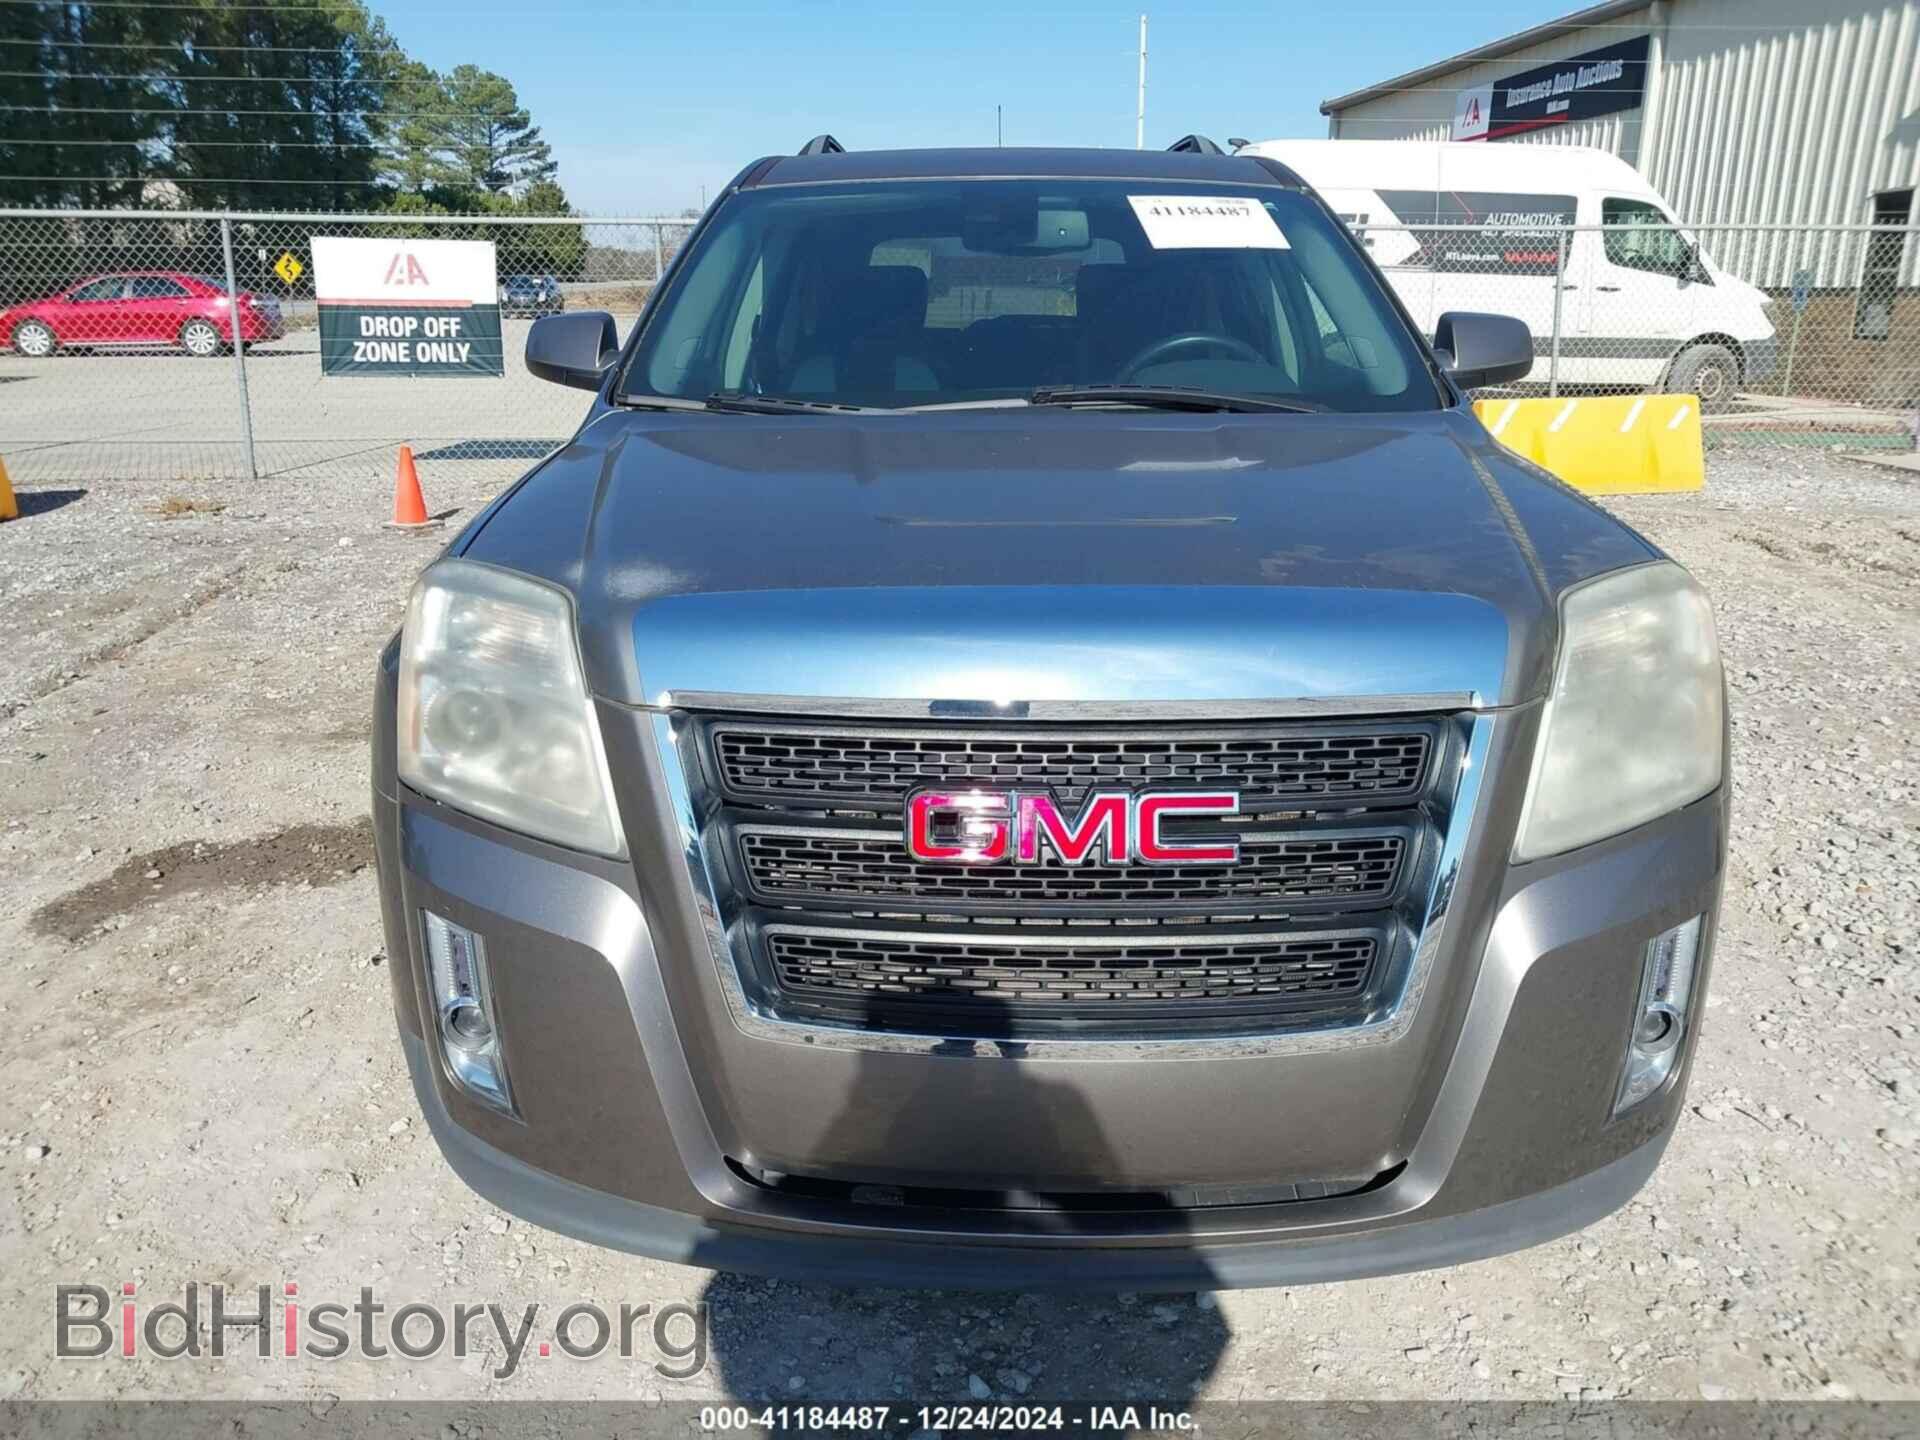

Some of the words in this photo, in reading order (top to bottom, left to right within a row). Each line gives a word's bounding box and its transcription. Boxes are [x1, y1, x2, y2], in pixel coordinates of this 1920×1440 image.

[1506, 79, 1552, 108] Insurance
[1552, 72, 1576, 95] Auto
[1575, 59, 1624, 89] Auctions
[1149, 206, 1250, 216] 41184487
[1484, 212, 1565, 225] AUTOMOTIVE
[359, 316, 418, 337] DROP
[424, 316, 462, 338] OFF
[353, 341, 410, 363] ZONE
[416, 342, 471, 363] ONLY
[906, 789, 1240, 865] GMC
